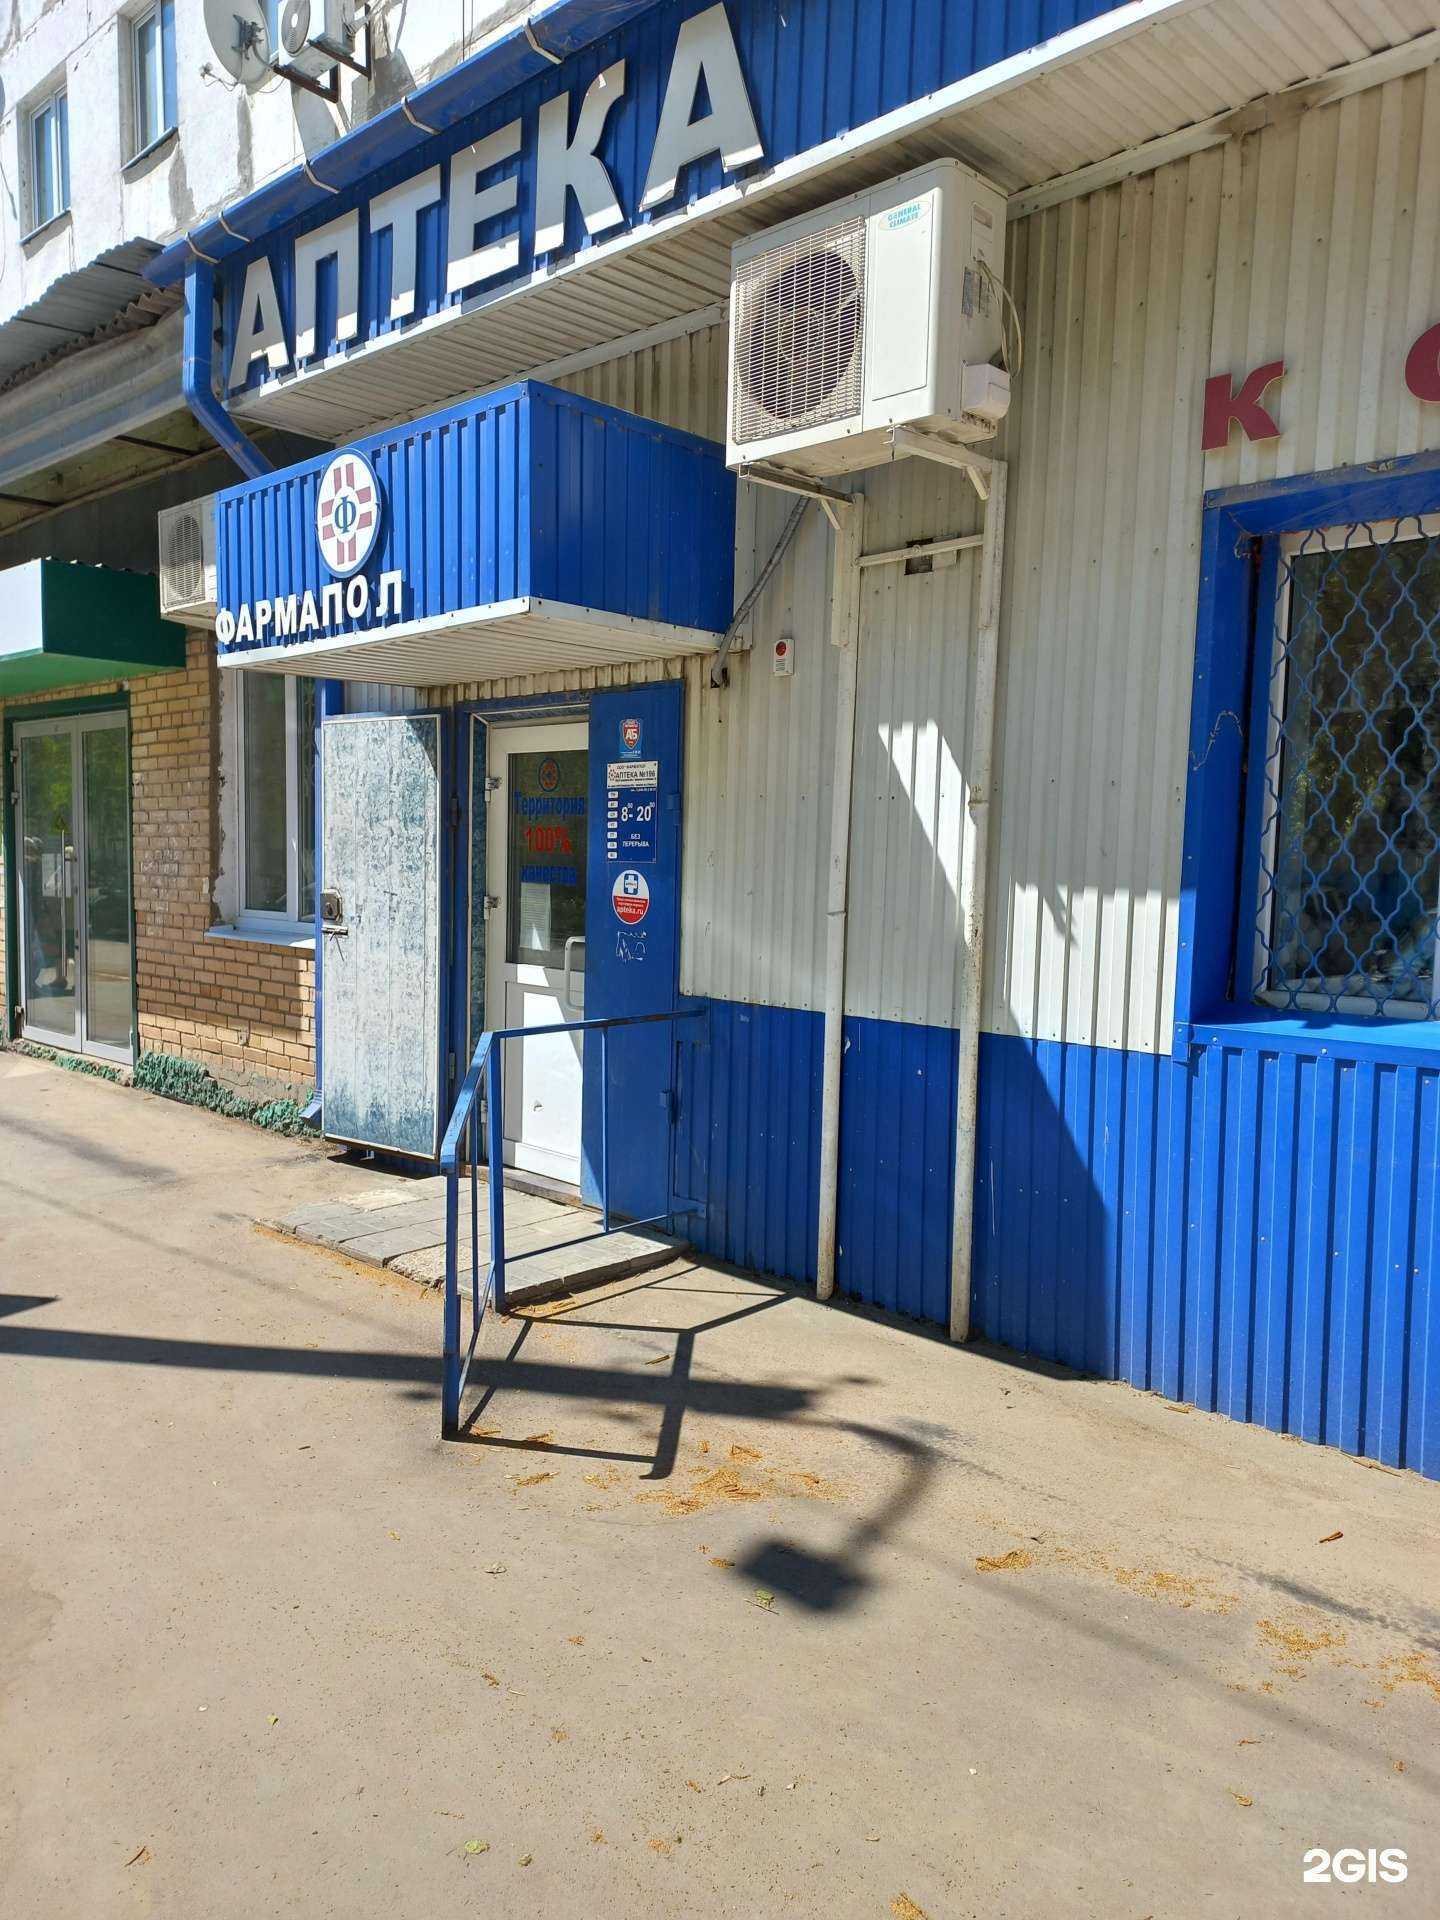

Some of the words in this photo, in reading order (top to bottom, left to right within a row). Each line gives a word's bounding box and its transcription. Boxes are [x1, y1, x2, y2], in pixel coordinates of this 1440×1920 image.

[228, 2, 765, 390] АПТЕКА
[334, 494, 357, 534] Ф
[215, 569, 403, 645] ФАРМАПОЛ
[615, 771, 638, 779] АПТЕКА
[636, 805, 652, 822] 20
[524, 824, 573, 855] 100%
